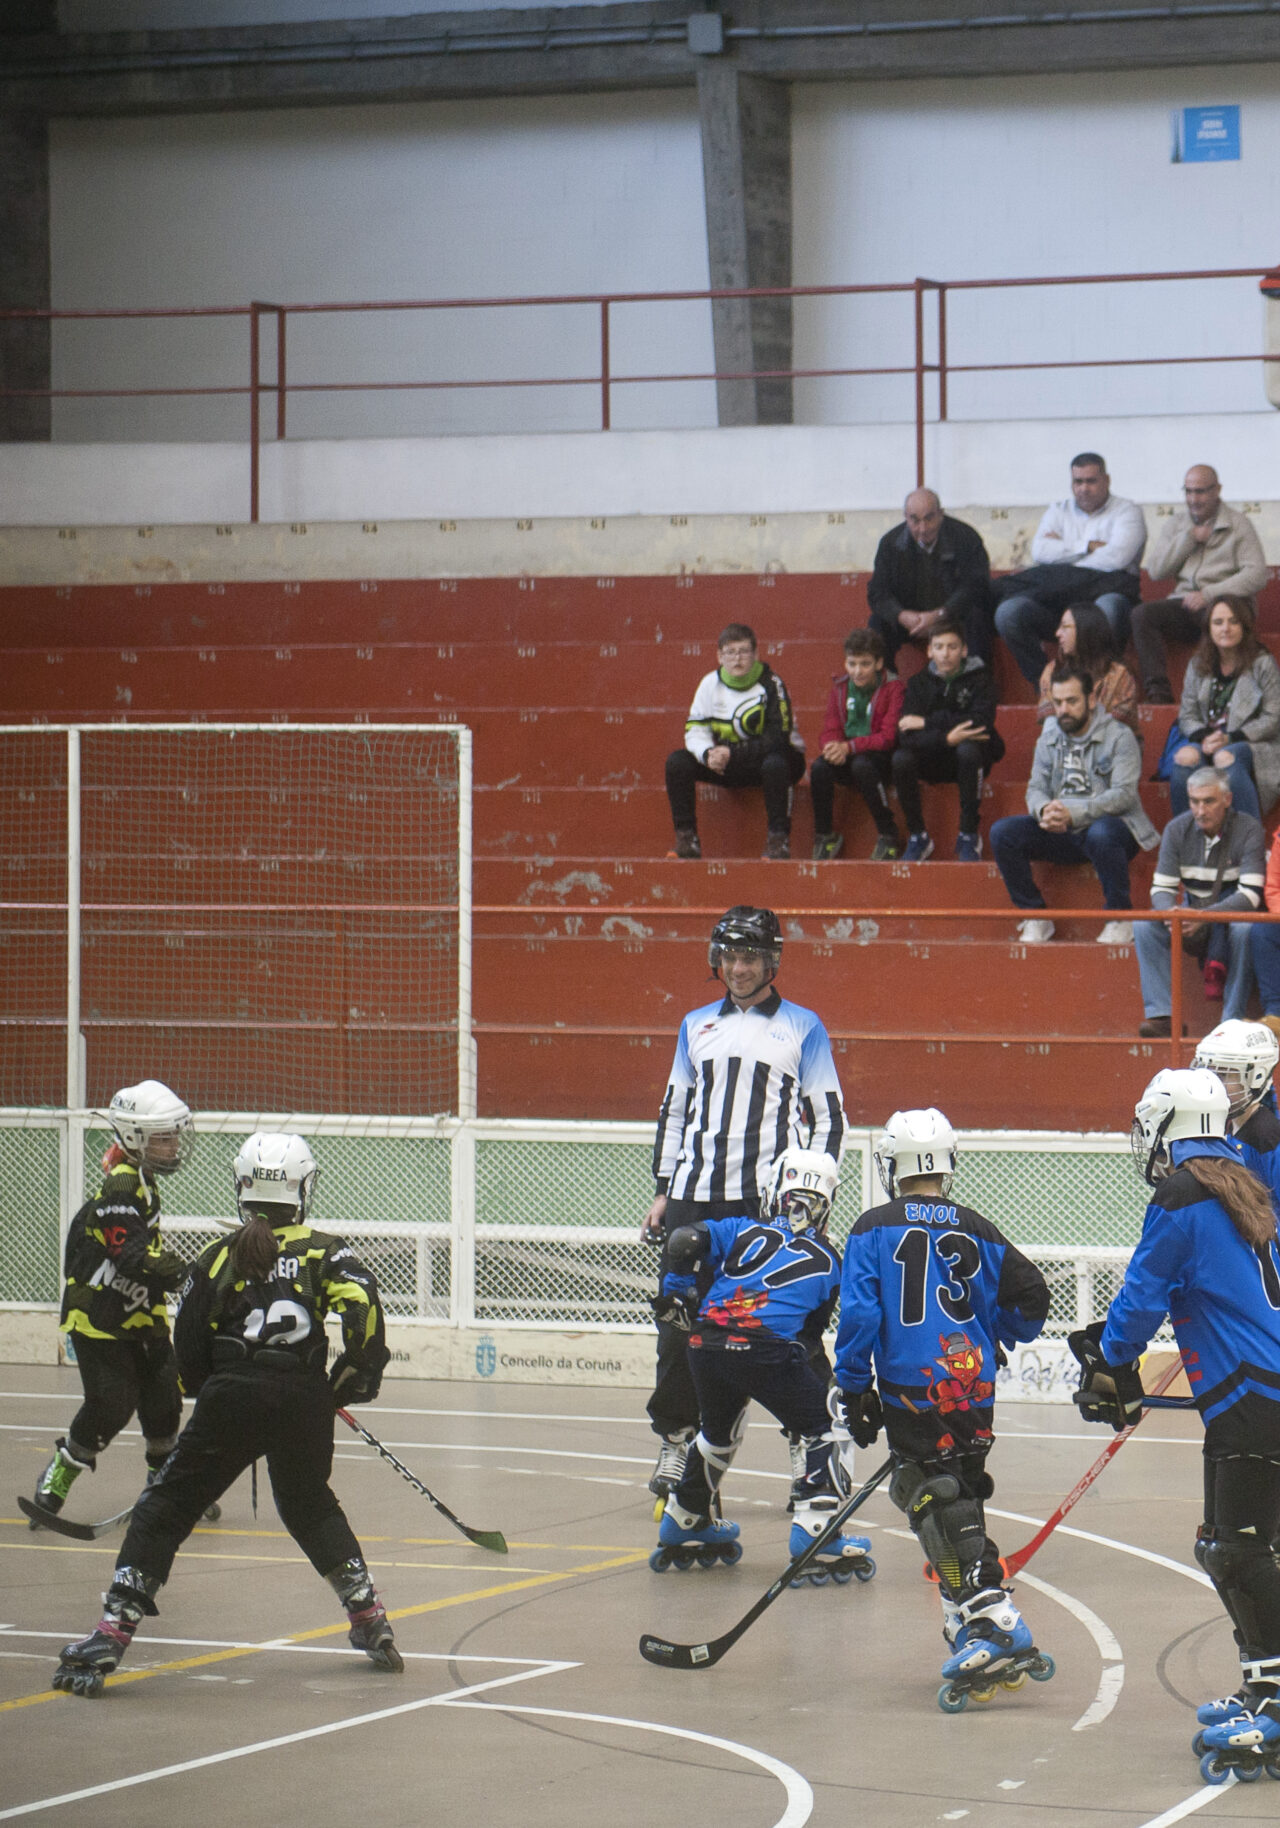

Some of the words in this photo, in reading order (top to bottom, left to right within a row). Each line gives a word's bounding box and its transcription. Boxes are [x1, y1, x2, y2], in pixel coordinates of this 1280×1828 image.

[1201, 1112, 1210, 1134] 11
[917, 1152, 935, 1173] 13
[252, 1167, 288, 1182] NEREA
[803, 1172, 821, 1189] 07
[905, 1203, 960, 1225] ENOL
[721, 1224, 833, 1290] 07
[893, 1227, 982, 1327] 13
[500, 1353, 553, 1368] Concello
[557, 1356, 572, 1370] da
[576, 1357, 622, 1372] Coruña
[1060, 1451, 1111, 1516] FISCHER
